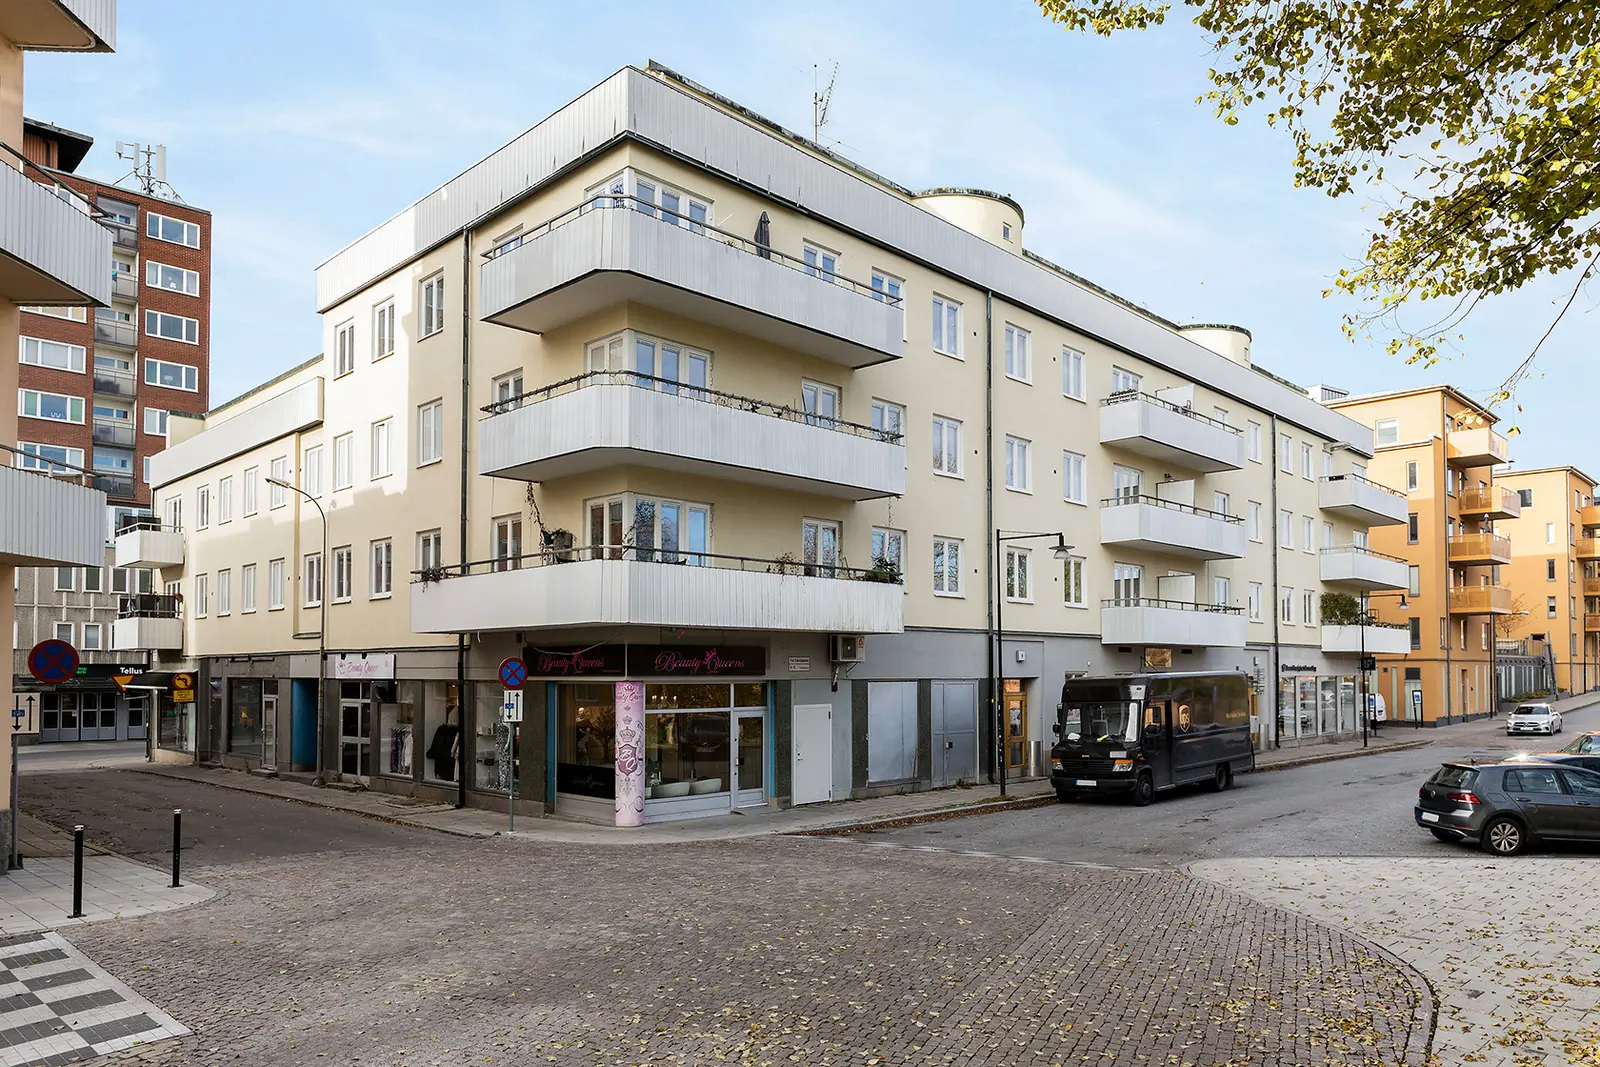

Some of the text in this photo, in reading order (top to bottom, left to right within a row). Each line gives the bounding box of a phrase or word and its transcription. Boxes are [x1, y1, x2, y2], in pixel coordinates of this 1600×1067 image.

[120, 667, 143, 675] Tellus
[537, 653, 605, 675] Beauty Queens
[654, 651, 745, 675] Beauty Queens
